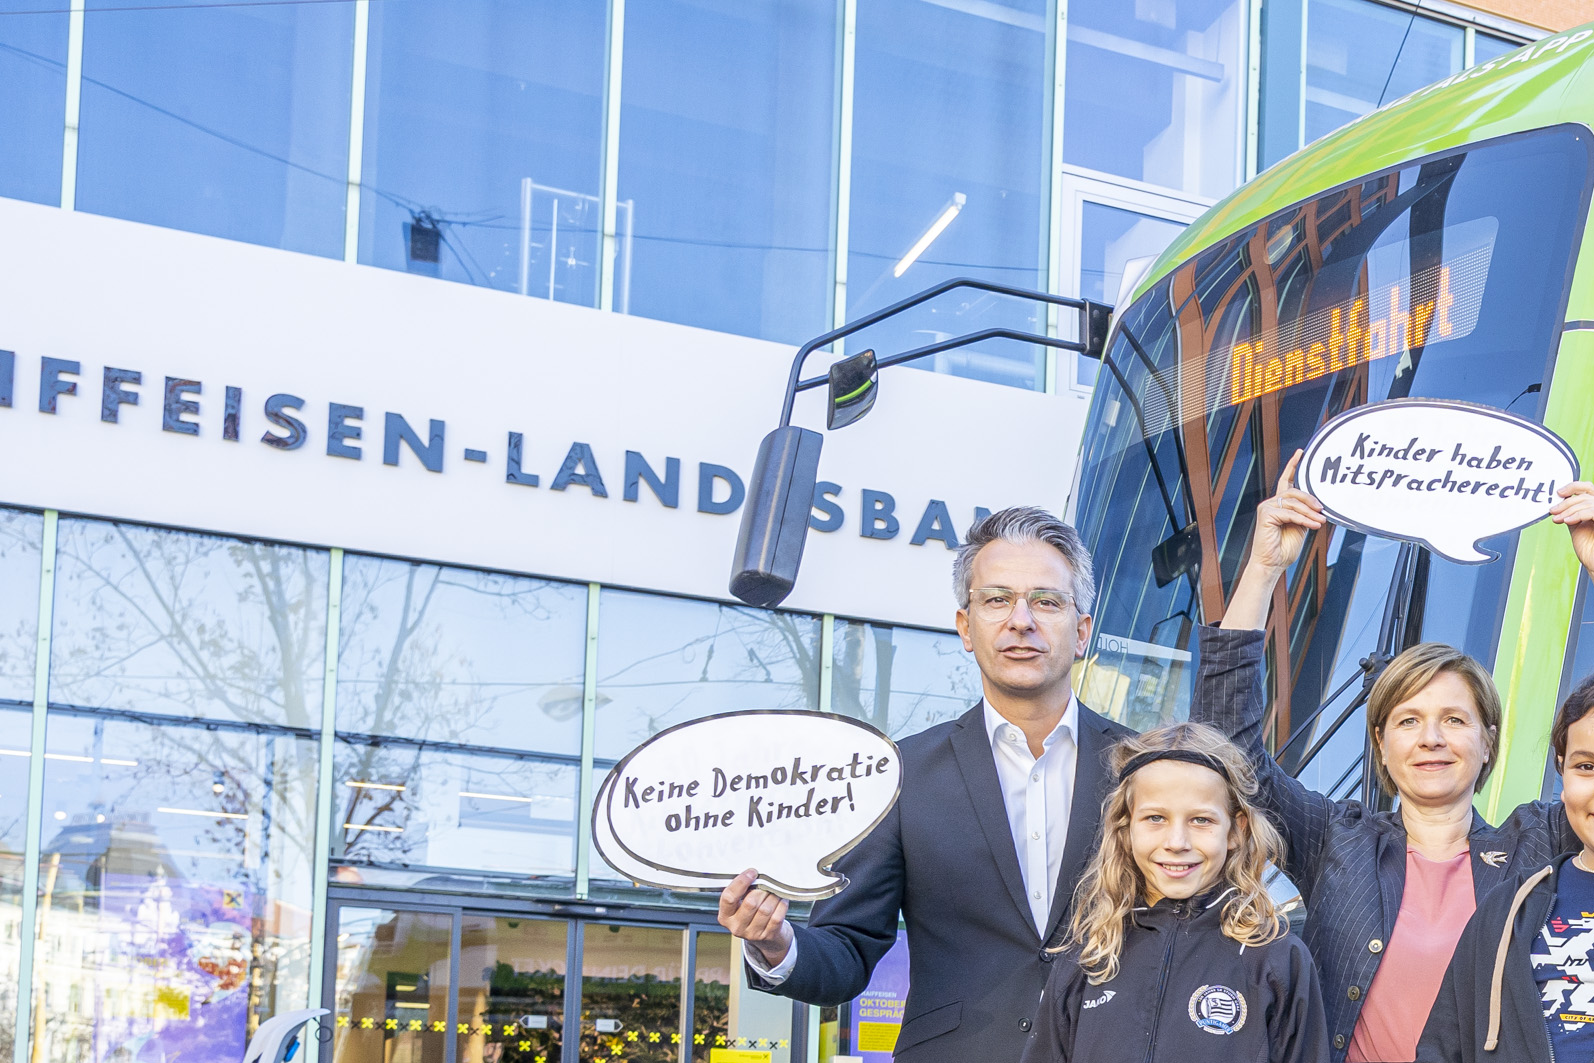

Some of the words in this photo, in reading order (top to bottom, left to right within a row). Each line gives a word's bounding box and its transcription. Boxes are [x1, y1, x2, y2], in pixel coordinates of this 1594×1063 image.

[1498, 29, 1594, 70] APP
[1231, 268, 1454, 405] Dienstfahrt
[1351, 432, 1443, 463] Kinder
[1451, 442, 1533, 472] haben
[624, 776, 700, 809] Keine
[712, 752, 890, 798] Demokratie
[665, 804, 735, 833] ohne
[748, 781, 855, 828] Kinder!
